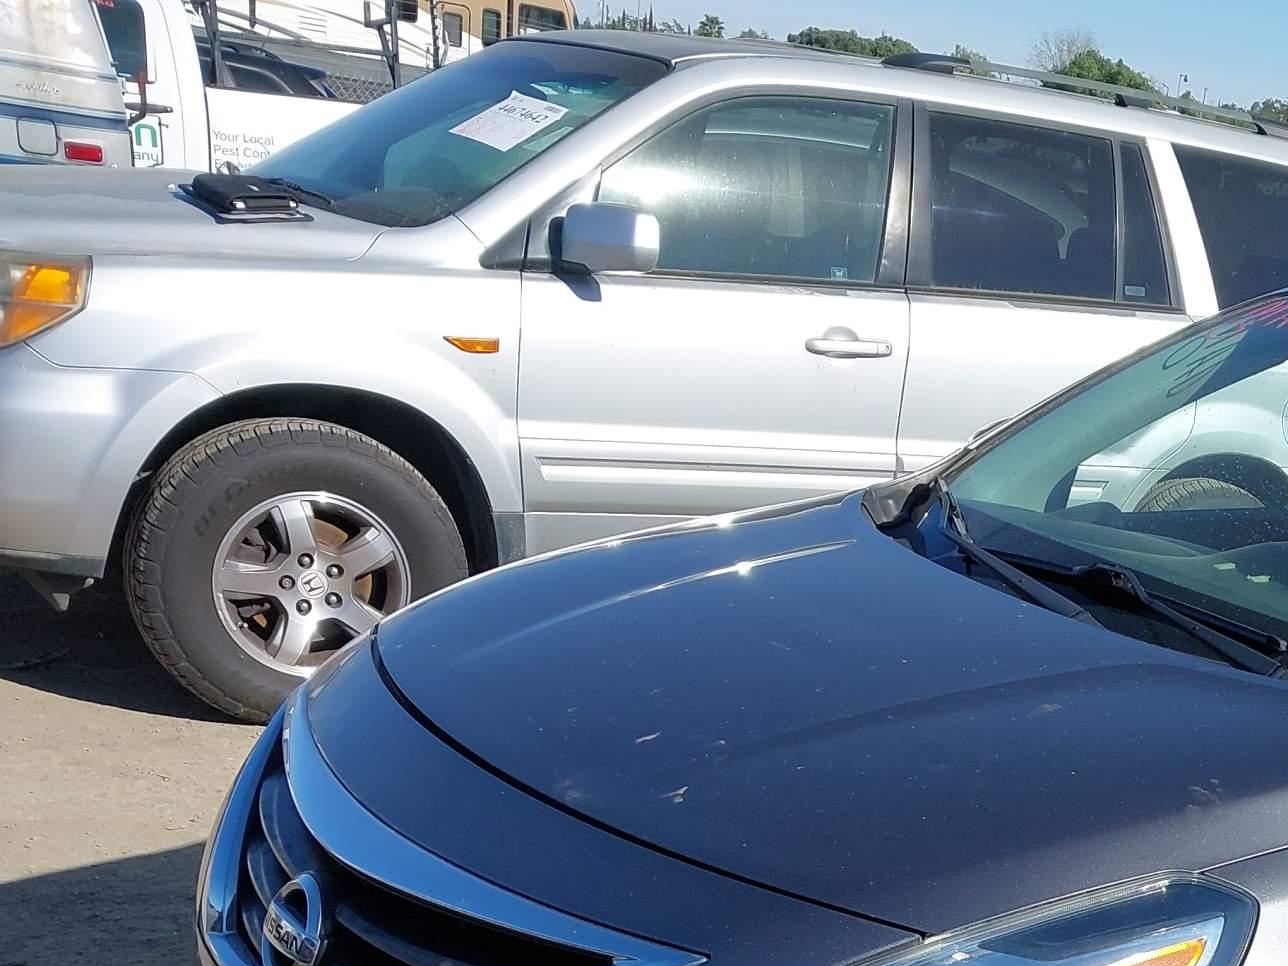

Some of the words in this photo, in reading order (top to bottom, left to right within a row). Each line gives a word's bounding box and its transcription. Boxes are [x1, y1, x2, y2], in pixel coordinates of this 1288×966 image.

[211, 129, 239, 142] Your
[243, 132, 274, 146] Local
[213, 143, 239, 157] Pest
